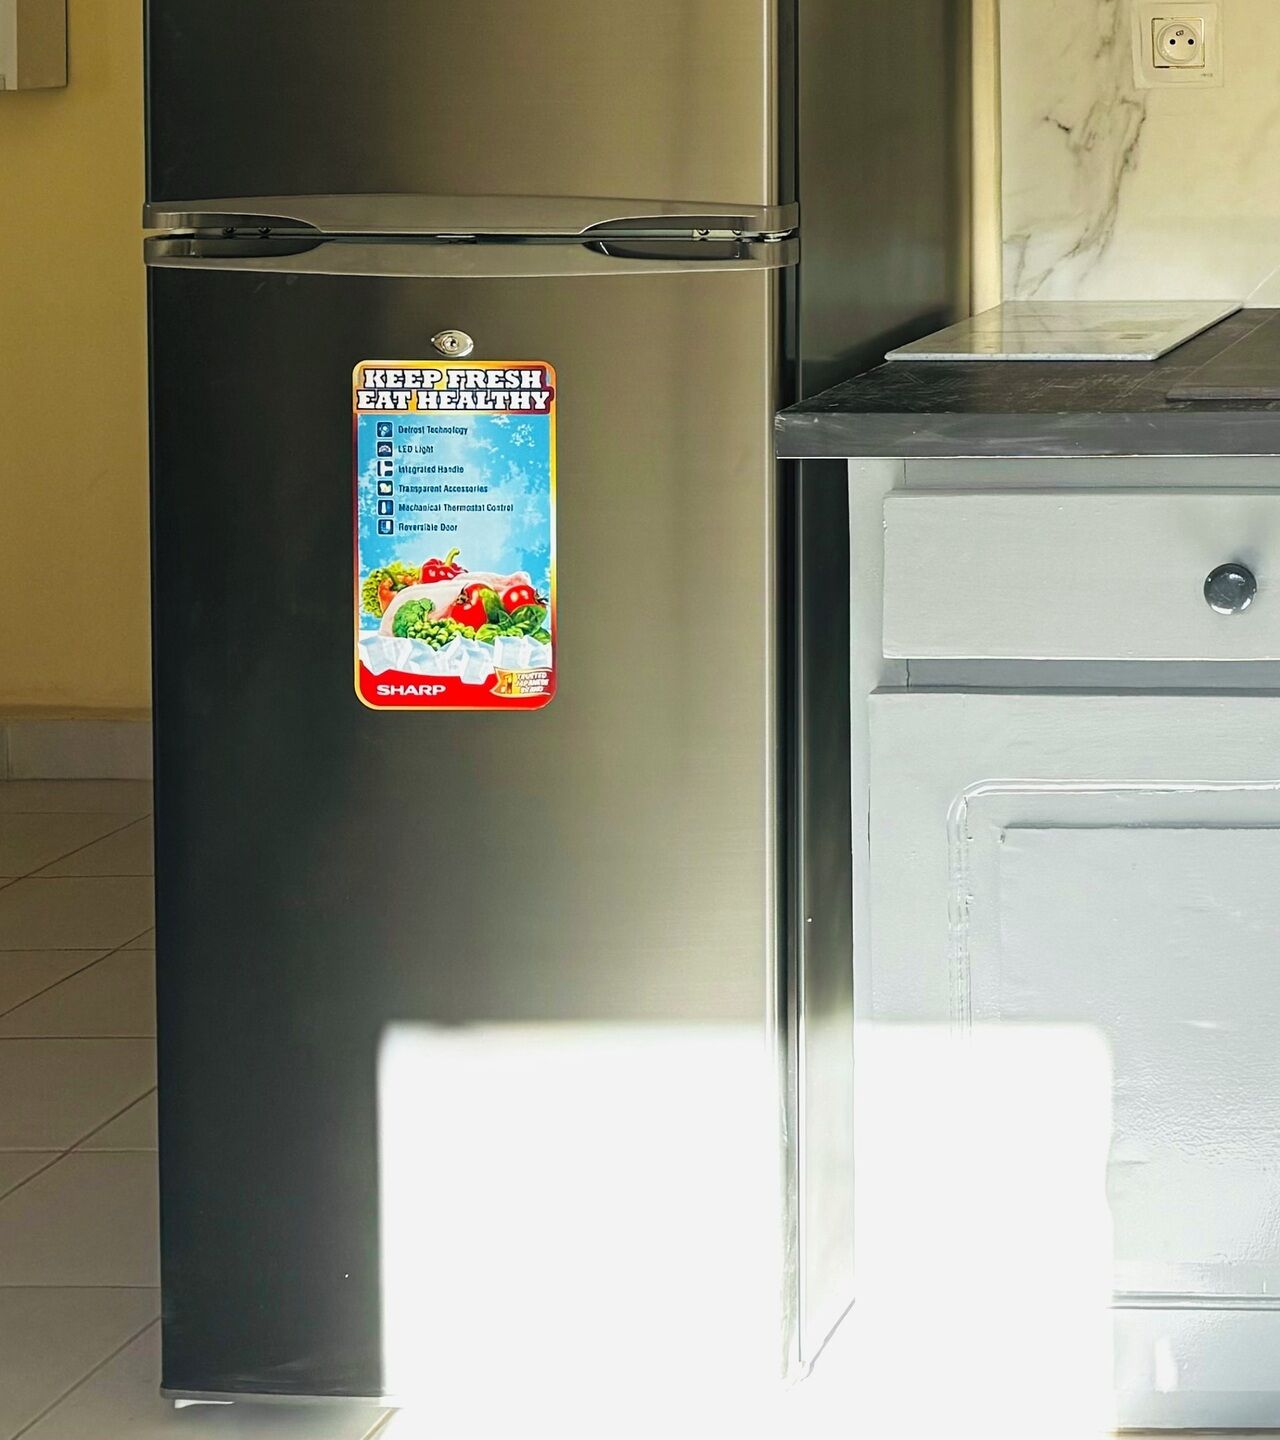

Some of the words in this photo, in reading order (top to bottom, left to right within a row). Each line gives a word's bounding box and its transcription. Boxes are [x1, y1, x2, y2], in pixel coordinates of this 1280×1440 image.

[363, 369, 443, 389] KEEP
[446, 369, 542, 389] FRESH
[357, 390, 412, 410] EAT
[416, 390, 550, 410] HEALTHY
[398, 425, 425, 434] Defrost
[427, 425, 468, 435] Technology
[398, 445, 413, 453] LED
[415, 445, 434, 455] Light
[398, 465, 436, 475] Integrated
[437, 465, 465, 474] Handle
[398, 484, 442, 494] Transparent
[443, 484, 488, 493] Accessories
[398, 503, 441, 512] Mechanical
[443, 503, 485, 512] Thermostat
[486, 503, 514, 512] Control
[398, 522, 438, 531] Reversible
[440, 523, 458, 532] Door
[376, 684, 447, 696] SHARP
